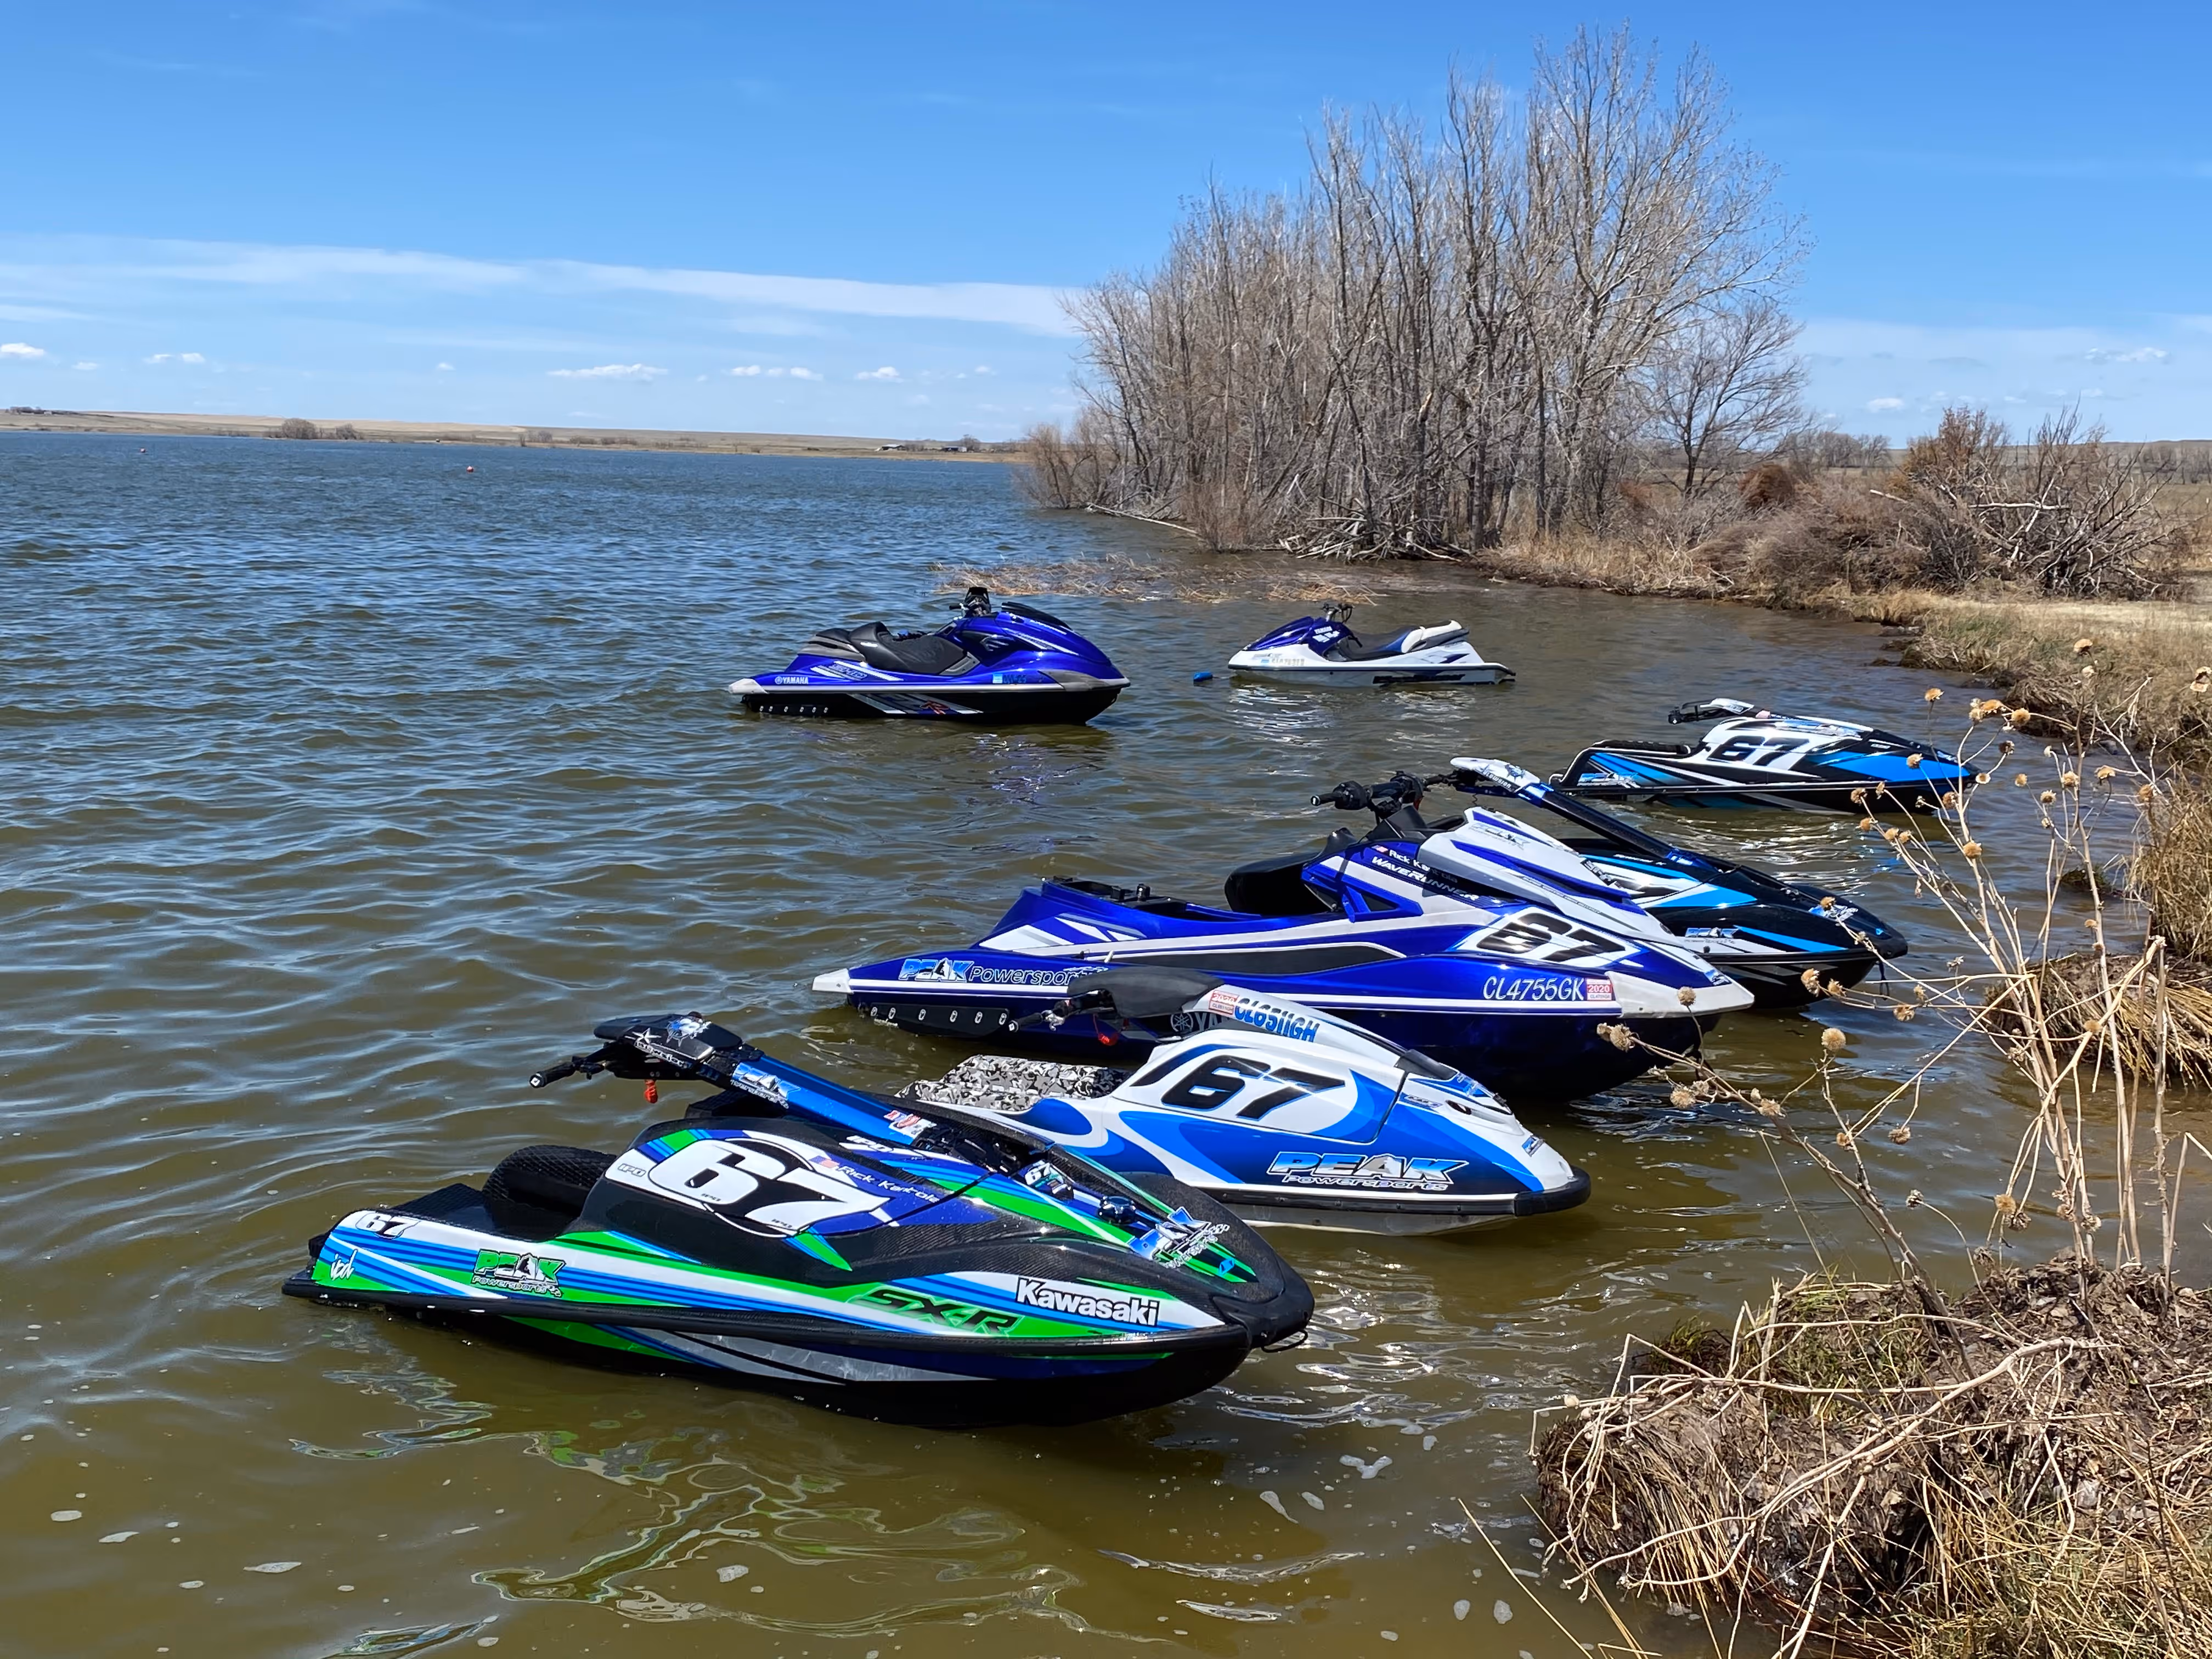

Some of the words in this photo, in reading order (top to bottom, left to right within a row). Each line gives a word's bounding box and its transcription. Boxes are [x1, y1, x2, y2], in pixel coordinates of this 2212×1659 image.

[783, 676, 809, 685] YAMAHA
[1707, 736, 1809, 766] 67
[1389, 849, 1410, 865] Rick
[1372, 856, 1480, 901] WAVERUNNER
[1476, 912, 1626, 962] 67
[898, 957, 975, 983] PEAK
[1483, 976, 1584, 1001] CL4755GK
[1588, 985, 1610, 993] 2020
[1160, 1054, 1346, 1121] 67
[837, 1165, 875, 1183] Rick
[1266, 1151, 1470, 1184] PEAK
[648, 1138, 893, 1234] 67
[355, 1212, 422, 1240] 67
[475, 1249, 567, 1286] PEAK
[1017, 1276, 1160, 1327] Kawasaki
